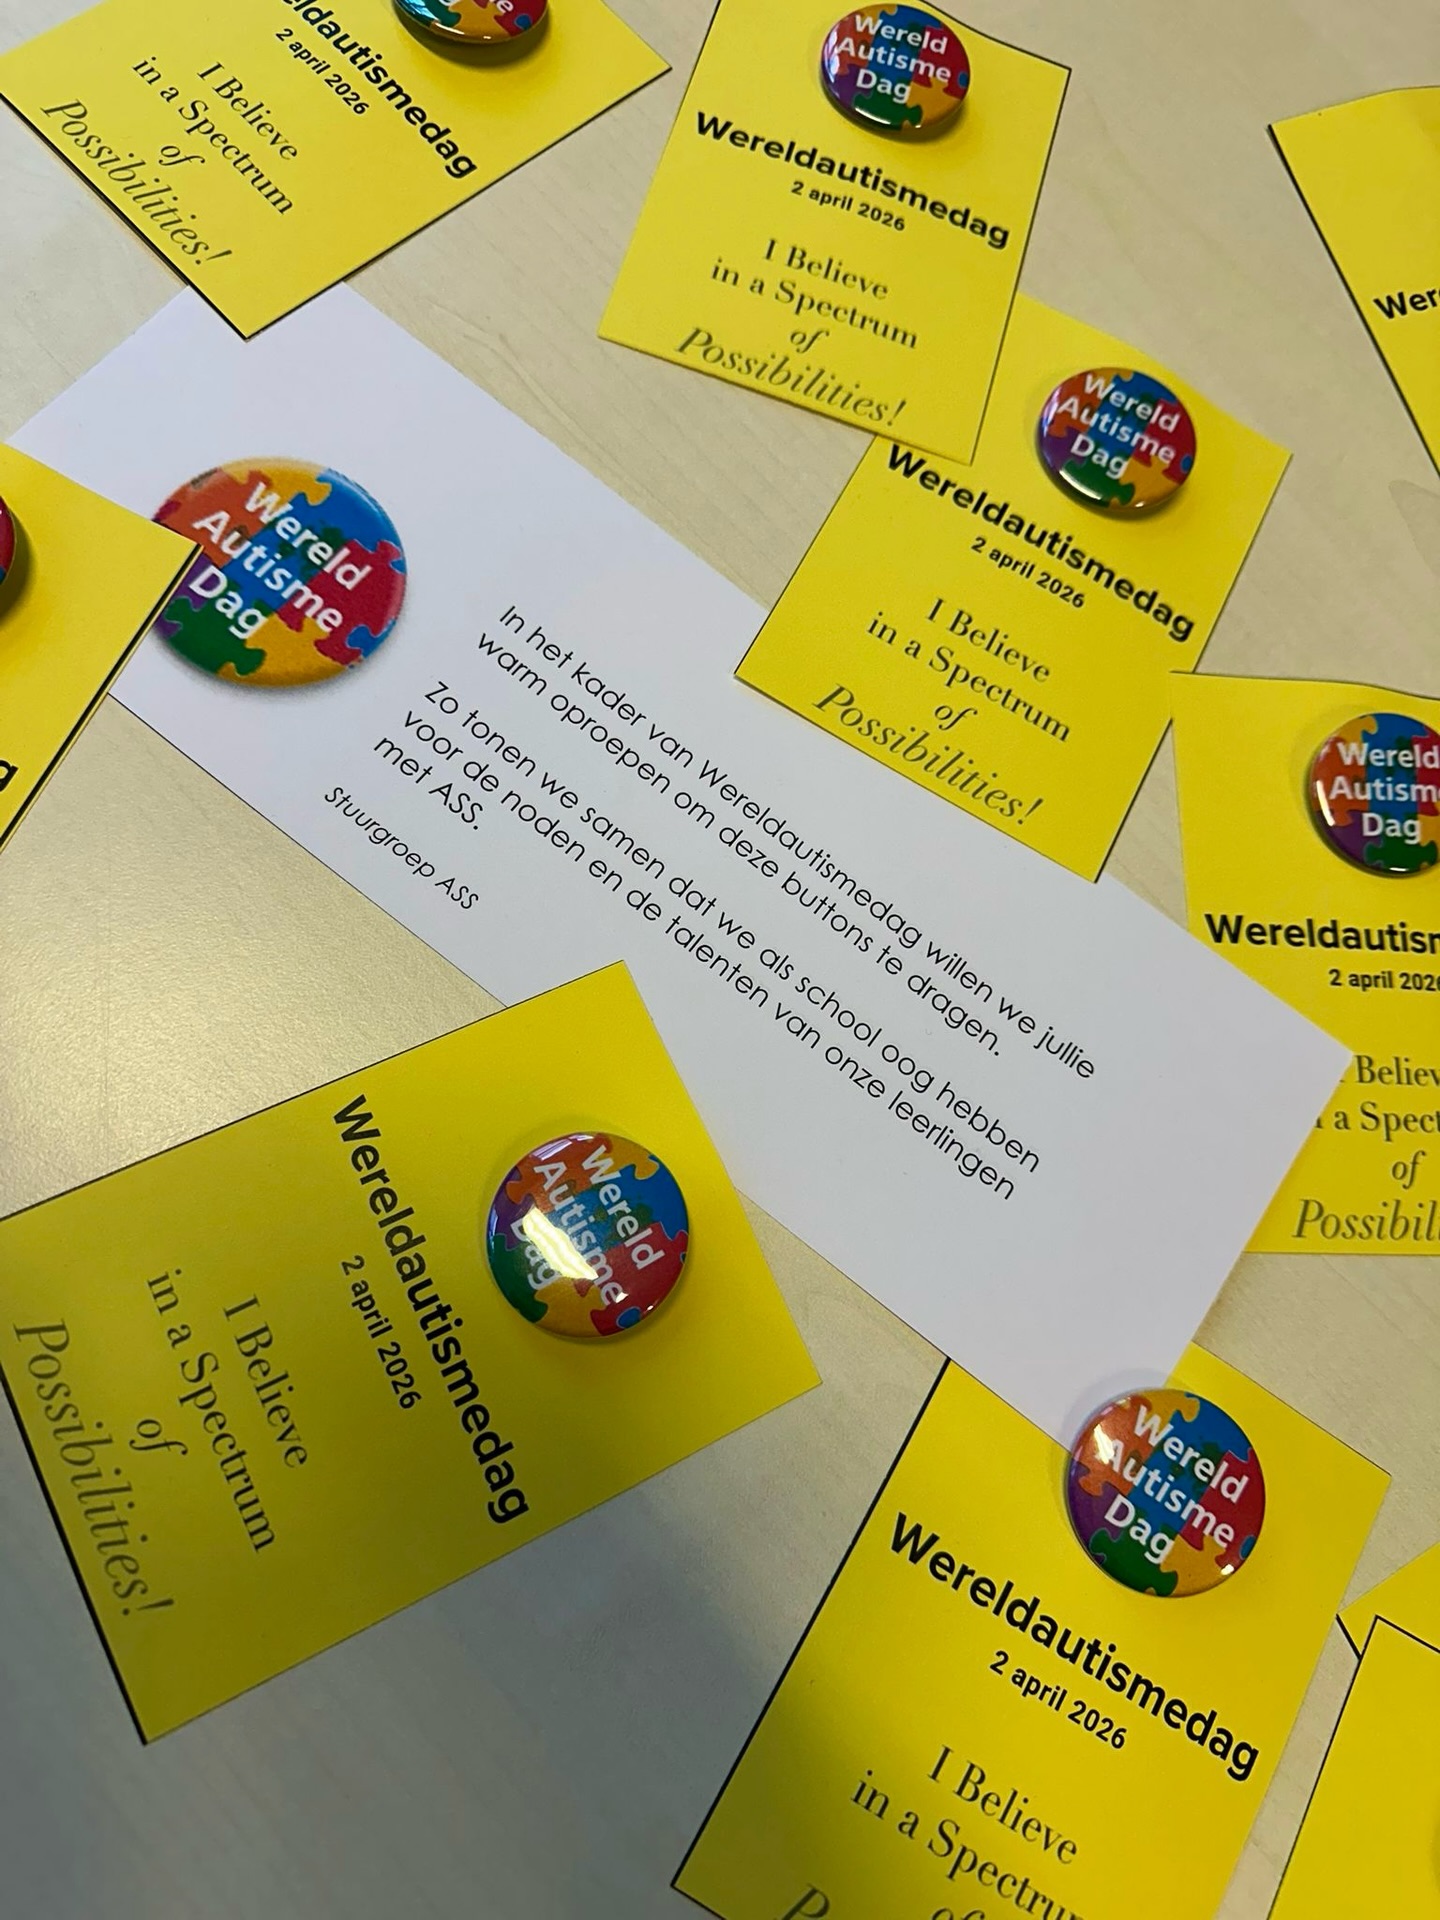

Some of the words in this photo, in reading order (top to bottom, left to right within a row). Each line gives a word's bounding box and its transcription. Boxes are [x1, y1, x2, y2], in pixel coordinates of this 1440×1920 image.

[197, 62, 225, 81] I
[276, 28, 293, 41] 2
[289, 41, 331, 75] april
[325, 74, 370, 115] 2026
[836, 36, 951, 82] Autisme
[854, 15, 948, 55] Wereld
[210, 76, 298, 161] Believe
[282, 0, 477, 178] ldautismedag
[856, 69, 911, 104] Dag
[133, 55, 163, 87] in
[159, 86, 179, 104] a
[179, 98, 294, 216] Spectrum
[161, 141, 205, 169] of
[41, 98, 233, 265] Possibilities!
[696, 112, 1010, 250] Wereldautismedag
[791, 181, 804, 196] 2
[809, 187, 853, 212] april
[858, 203, 905, 231] 2026
[710, 258, 739, 286] in
[750, 277, 764, 296] a
[774, 280, 918, 349] Spectrum
[763, 238, 777, 261] I
[785, 245, 889, 301] Believe
[674, 328, 906, 426] Possibilities!
[790, 326, 829, 354] of
[1056, 396, 1175, 464] Autisme
[1084, 374, 1180, 432] Wereld
[1071, 433, 1130, 480] Dag
[192, 509, 344, 632] Autisme
[245, 481, 371, 591] Wereld
[888, 443, 1195, 642] Wereldautismedag
[971, 536, 985, 553] 2
[988, 546, 1034, 580] april
[1036, 571, 1085, 609] 2026
[188, 565, 270, 640] Dag
[867, 612, 897, 645] in
[904, 635, 921, 658] a
[928, 645, 1071, 743] Spectrum
[925, 598, 943, 622] I
[946, 608, 1050, 684] Believe
[813, 682, 1044, 826] Possibilities!
[934, 703, 978, 731] of
[373, 736, 432, 785] met
[428, 781, 484, 830] ASS.
[1328, 775, 1440, 803] Autism
[1336, 741, 1440, 769] Wereld
[324, 786, 435, 879] Stuurgroep
[435, 876, 479, 910] ASS
[477, 632, 548, 696] warm
[550, 693, 670, 794] oproepen
[674, 790, 716, 829] om
[718, 823, 780, 879] deze
[781, 871, 874, 954] buttons
[876, 944, 904, 976] te
[907, 969, 1001, 1057] dragen.
[499, 605, 525, 635] In
[526, 627, 575, 670] het
[570, 661, 647, 728] kader
[648, 722, 694, 768] van
[698, 759, 922, 950] Wereldautismedag
[926, 940, 994, 1003] willen
[998, 996, 1037, 1036] we
[1033, 1026, 1095, 1080] jullie
[1361, 812, 1421, 844] Dag
[402, 711, 464, 762] voor
[463, 755, 500, 794] de
[500, 788, 586, 863] noden
[588, 859, 624, 892] en
[626, 886, 662, 922] de
[665, 913, 769, 1008] talenten
[775, 1002, 821, 1049] van
[824, 1043, 886, 1099] onze
[887, 1090, 1016, 1201] leerlingen
[424, 681, 458, 715] Zo
[462, 709, 537, 778] tonen
[540, 769, 580, 810] we
[580, 806, 667, 881] samen
[668, 874, 717, 917] dat
[717, 911, 756, 949] we
[759, 942, 795, 981] als
[794, 975, 883, 1049] school
[881, 1042, 935, 1094] oog
[935, 1081, 1040, 1173] hebben
[1204, 913, 1440, 954] Wereldautis
[1329, 969, 1342, 986] 2
[1348, 970, 1393, 992] april
[1354, 1054, 1440, 1087] Believ
[1334, 1110, 1351, 1130] a
[581, 1145, 665, 1270] Wereld
[1392, 1150, 1427, 1190] of
[534, 1161, 623, 1306] Autisme
[1291, 1198, 1440, 1241] Possibil
[146, 1269, 182, 1314] in
[342, 1255, 364, 1275] 2
[166, 1328, 193, 1349] a
[223, 1294, 258, 1320] I
[333, 1093, 529, 1525] Wereldautismedag
[350, 1280, 386, 1341] april
[232, 1323, 307, 1468] Believe
[378, 1342, 419, 1410] 2026
[12, 1320, 174, 1617] Possibilities!
[128, 1419, 188, 1456] of
[178, 1353, 275, 1554] Spectrum
[1134, 1404, 1249, 1503] Wereld
[1095, 1438, 1235, 1548] Autisme
[1104, 1494, 1175, 1564] Dag
[889, 1513, 1259, 1782] Wereldautismedag
[990, 1650, 1010, 1676] 2
[1011, 1666, 1069, 1714] april
[1069, 1699, 1127, 1751] 2026
[850, 1769, 890, 1820] in
[898, 1810, 920, 1840] a
[927, 1745, 954, 1783] I
[952, 1760, 1078, 1864] Believe
